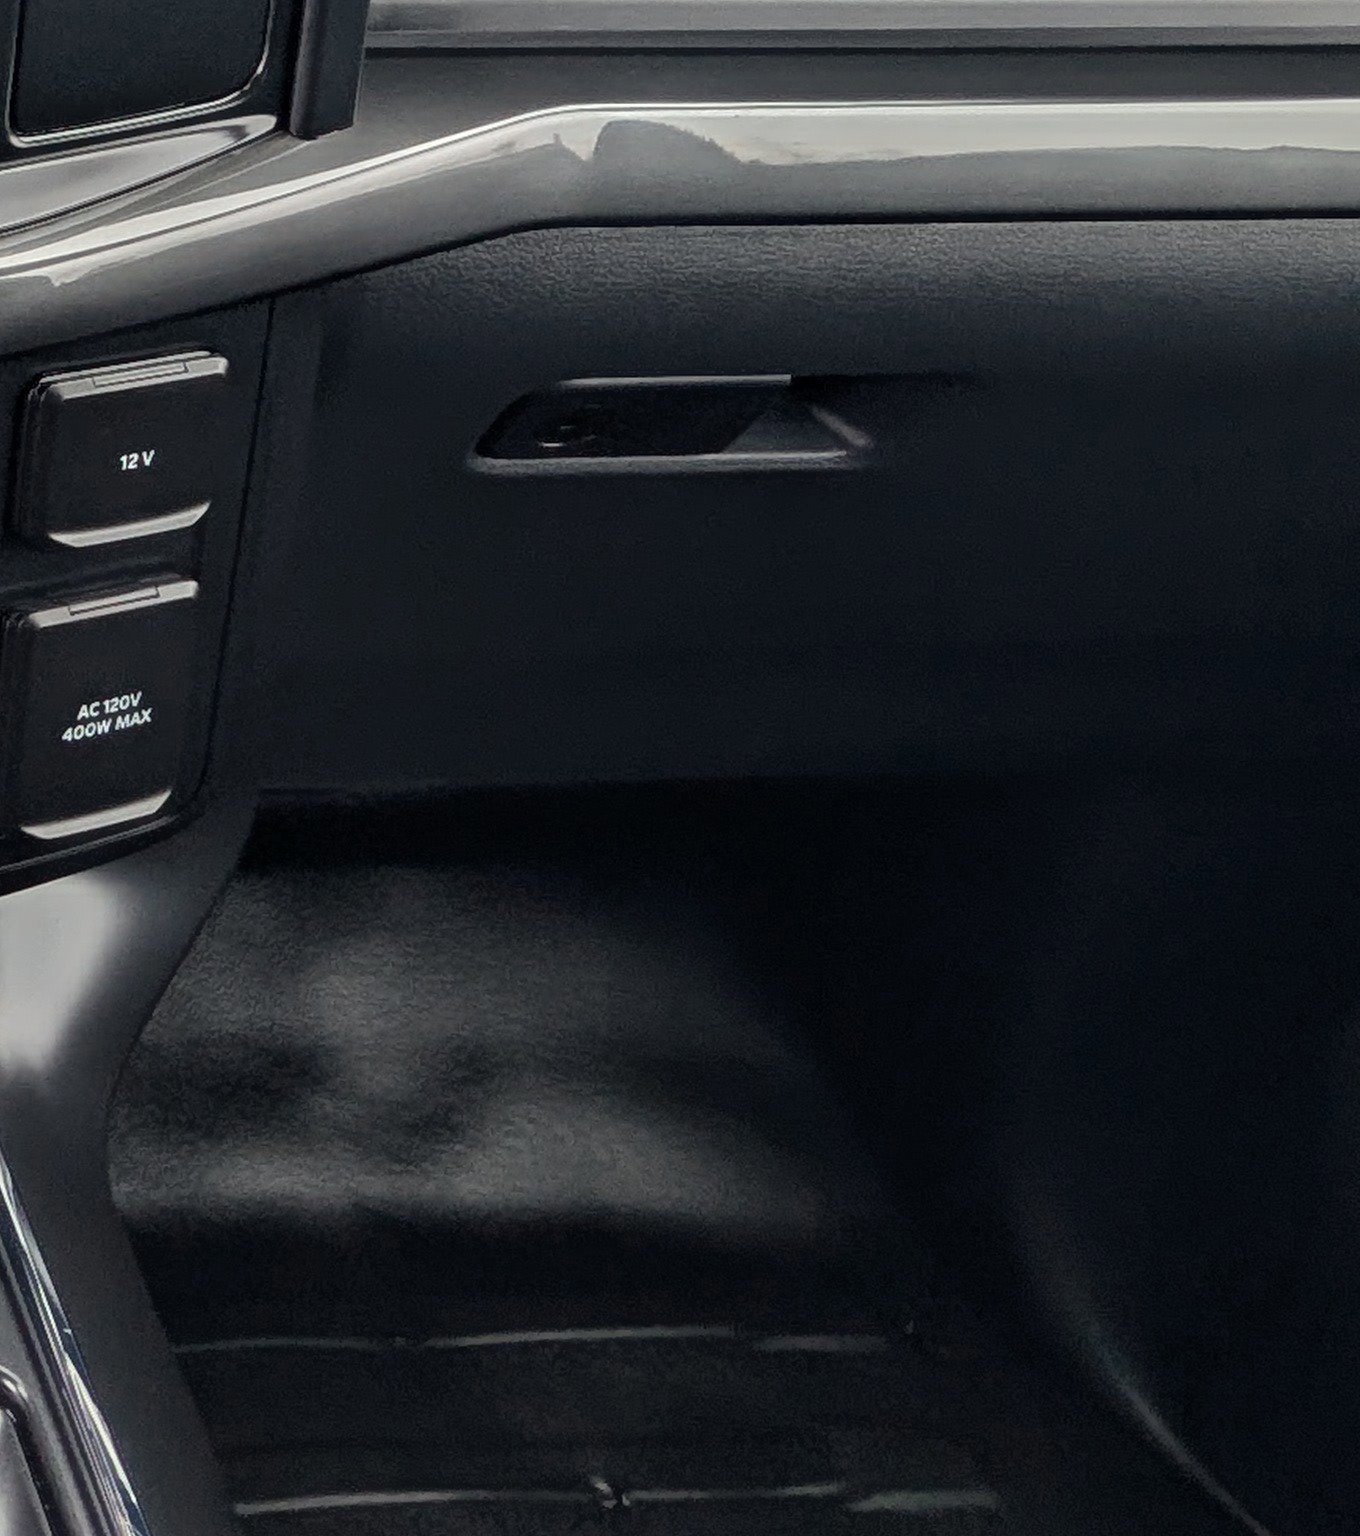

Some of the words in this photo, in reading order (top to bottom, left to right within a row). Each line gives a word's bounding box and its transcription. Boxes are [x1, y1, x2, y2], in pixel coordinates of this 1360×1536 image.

[119, 452, 140, 471] 12
[141, 449, 155, 467] V
[76, 701, 101, 721] AC
[103, 691, 142, 714] 120V
[61, 718, 112, 741] 400W
[114, 707, 153, 731] MAX
